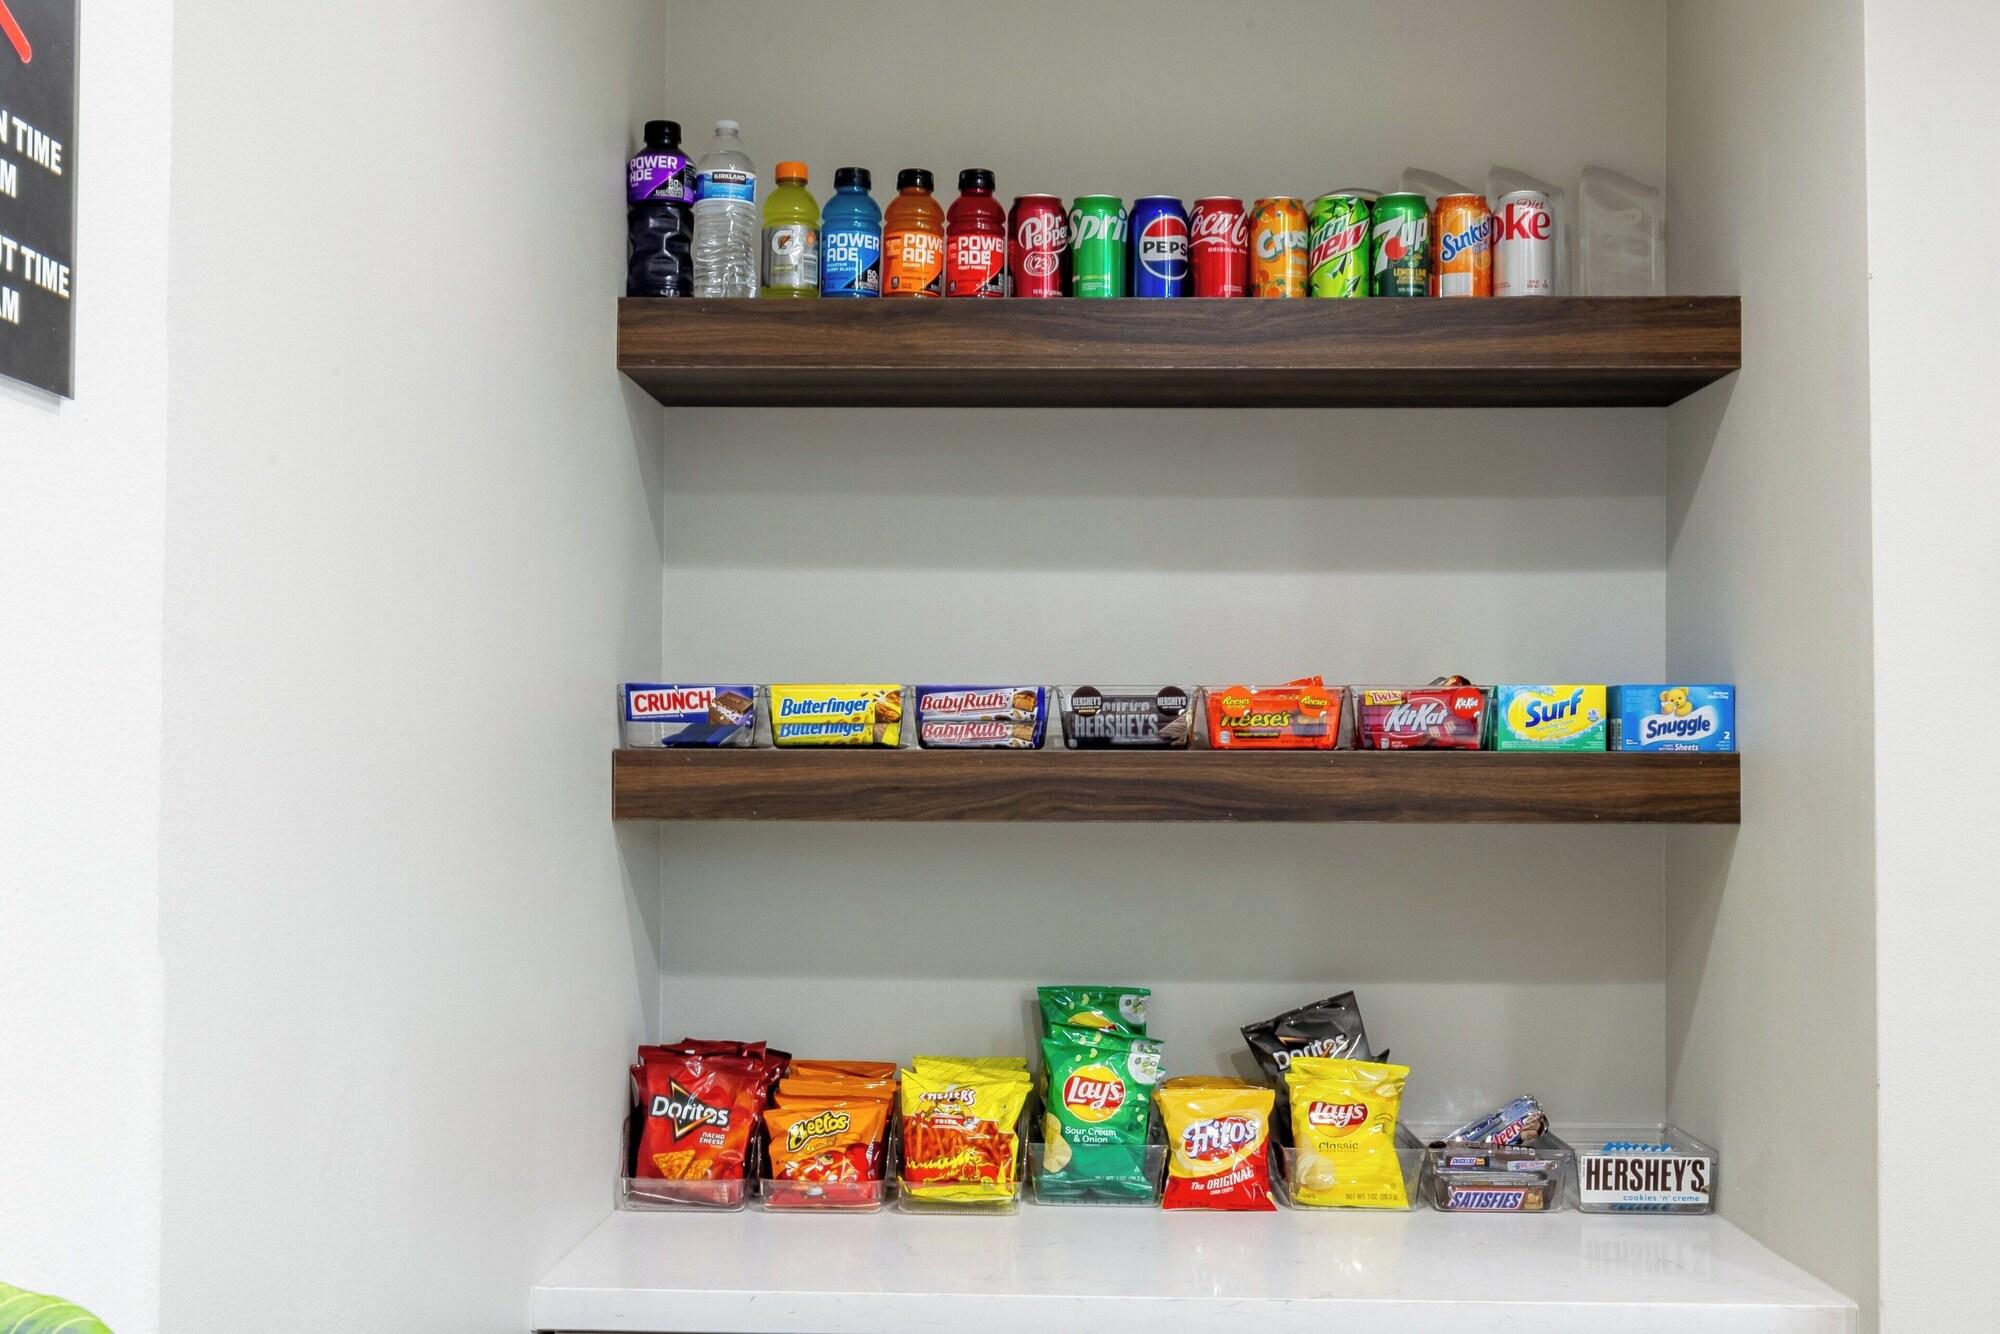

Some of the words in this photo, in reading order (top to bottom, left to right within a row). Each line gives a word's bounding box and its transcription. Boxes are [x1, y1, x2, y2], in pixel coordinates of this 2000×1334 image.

[12, 116, 62, 176] TIME
[630, 155, 678, 170] POWER
[714, 173, 746, 181] KIRKLAND
[1041, 213, 1062, 231] Dr
[1491, 203, 1551, 245] oke
[827, 232, 880, 251] POWER
[1018, 217, 1068, 251] Pepper
[827, 247, 859, 262] ADE
[903, 248, 935, 264] ADE
[958, 250, 991, 265] ADE
[0, 234, 18, 273] T
[21, 245, 70, 299] TIME
[0, 286, 20, 325] M
[633, 690, 712, 713] CRUNCH
[780, 698, 870, 716] Butterfinger
[1072, 697, 1102, 706] HERSHEY'S
[1157, 697, 1187, 706] HERSHEY'S
[1525, 688, 1584, 728] Surf
[780, 723, 865, 737] Butterfinger
[1074, 714, 1159, 738] HERSHEY'S
[1646, 715, 1711, 739] Snuggle
[1723, 731, 1731, 740] 2
[1674, 743, 1699, 751] Sheets
[1066, 1076, 1123, 1109] Lay's
[652, 1096, 730, 1126] Doritos
[702, 1132, 726, 1140] NACHO
[1065, 1126, 1086, 1135] Sour
[1088, 1127, 1117, 1137] Cream
[1073, 1135, 1080, 1143] &
[1082, 1134, 1109, 1143] Onion
[1183, 1119, 1259, 1158] Fritos
[699, 1137, 725, 1146] CHEESE
[1206, 1166, 1255, 1190] ORIGINAL
[1585, 1158, 1706, 1192] HERSHEY'S
[1450, 1191, 1523, 1209] SATISFIES
[1623, 1193, 1657, 1202] cookies
[1672, 1194, 1700, 1202] creme
